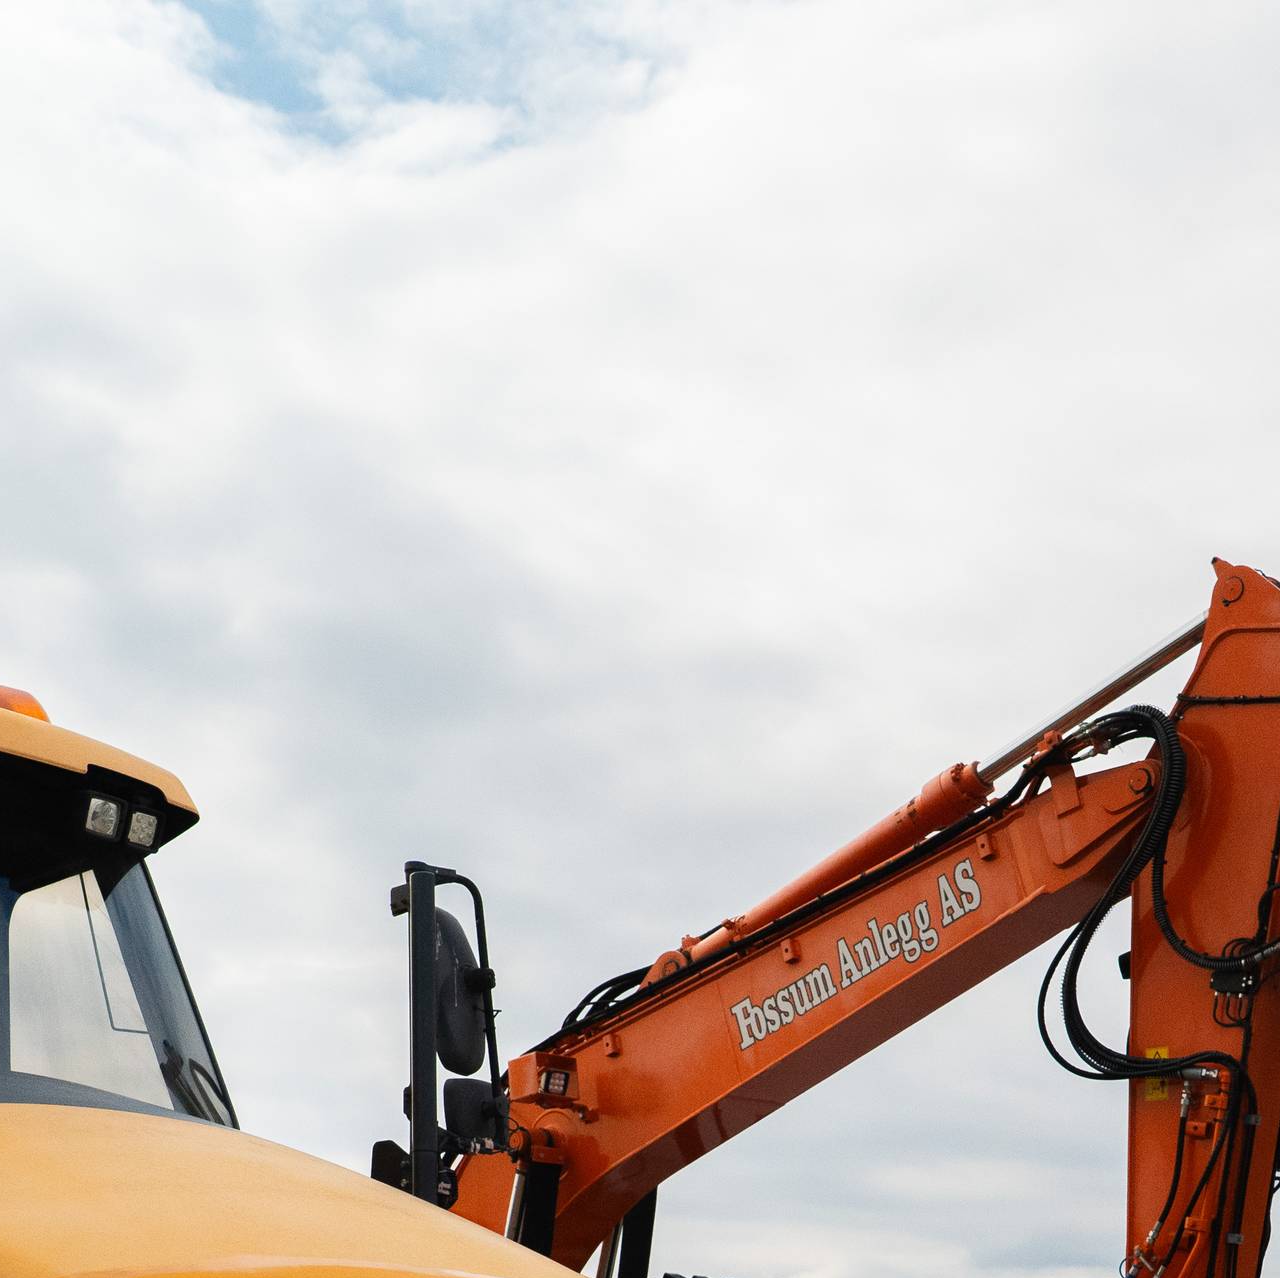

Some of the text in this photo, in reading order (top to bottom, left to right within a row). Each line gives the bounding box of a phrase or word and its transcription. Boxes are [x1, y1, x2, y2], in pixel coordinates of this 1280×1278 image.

[730, 857, 982, 1050] Fossum Anlegg AS
